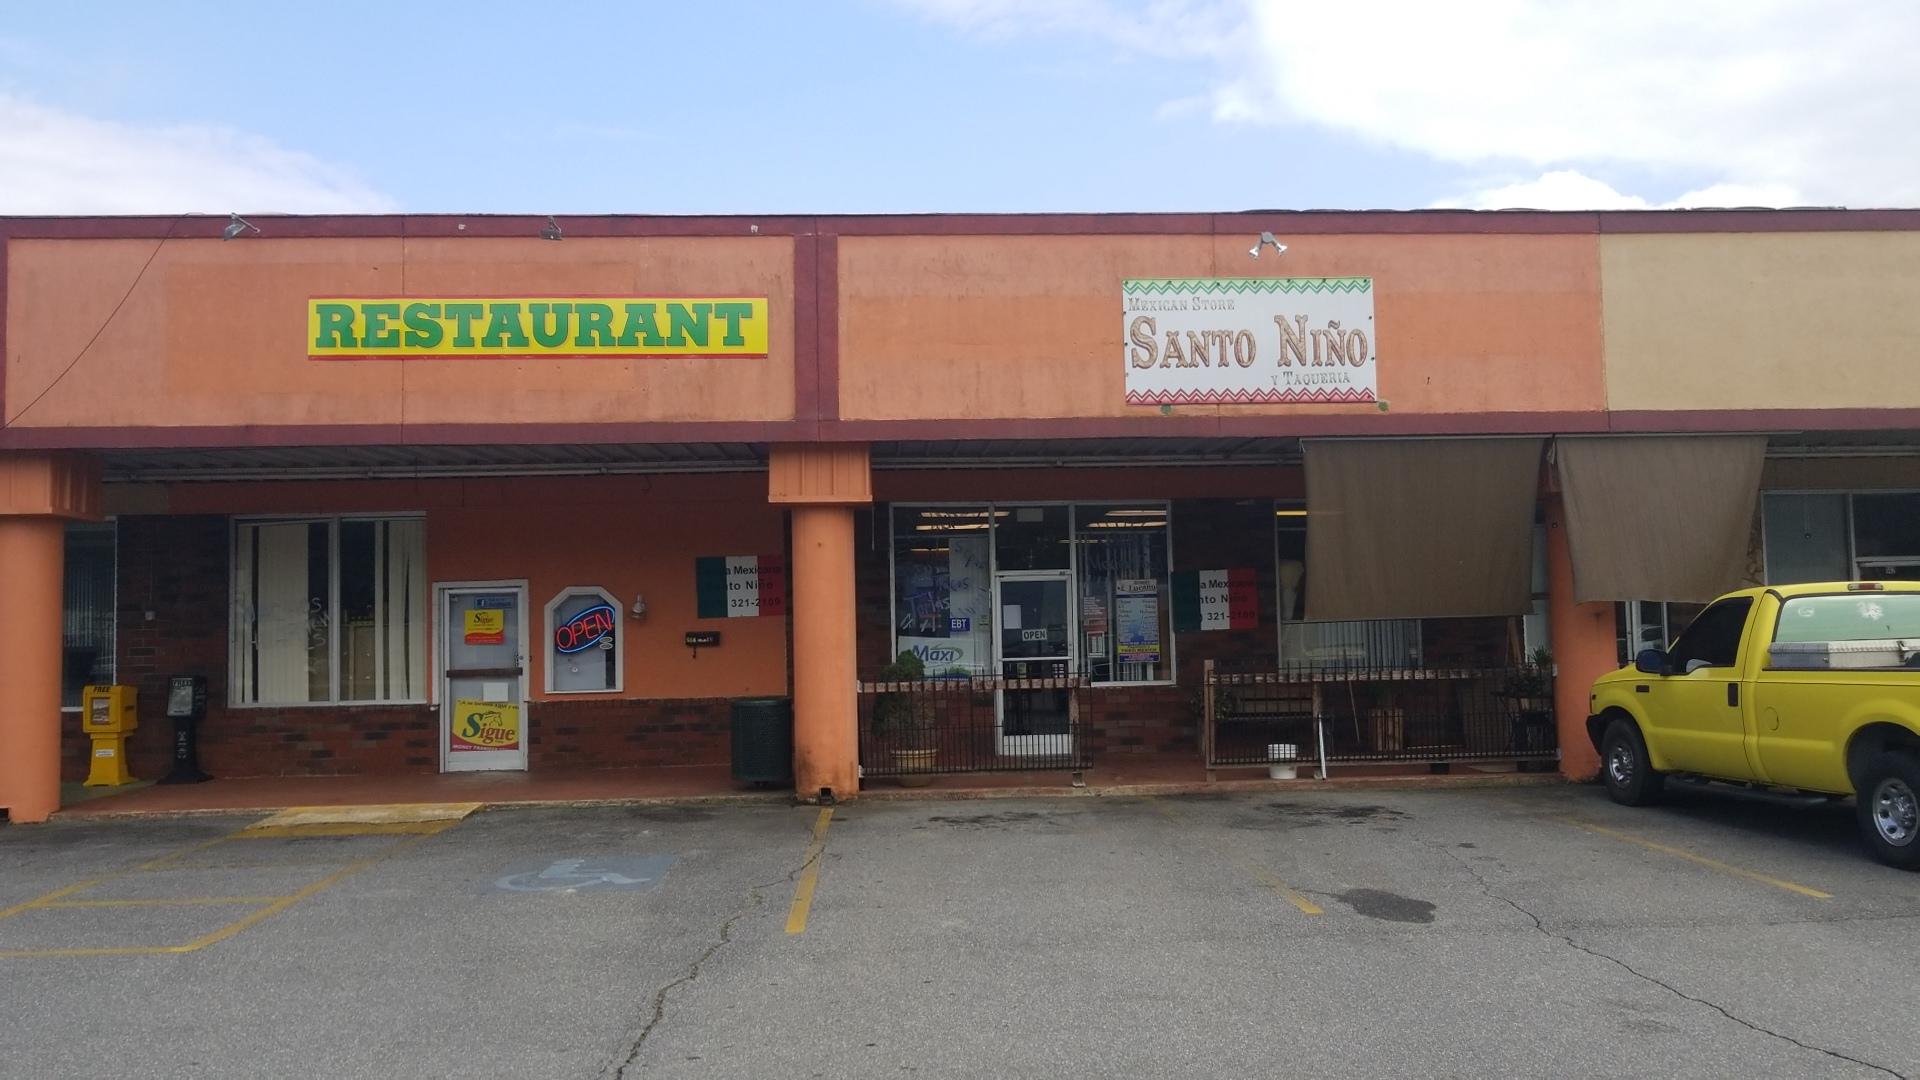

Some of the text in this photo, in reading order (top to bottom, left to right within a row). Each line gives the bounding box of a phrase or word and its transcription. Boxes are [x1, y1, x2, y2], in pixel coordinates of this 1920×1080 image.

[316, 303, 753, 348] RESTAURANT
[1129, 314, 1369, 370] SANTO NIÑO
[556, 609, 613, 649] OPEN
[951, 618, 967, 629] EBT
[1023, 630, 1046, 640] OPEN
[912, 645, 954, 662] Maxi
[461, 712, 516, 744] Sigue
